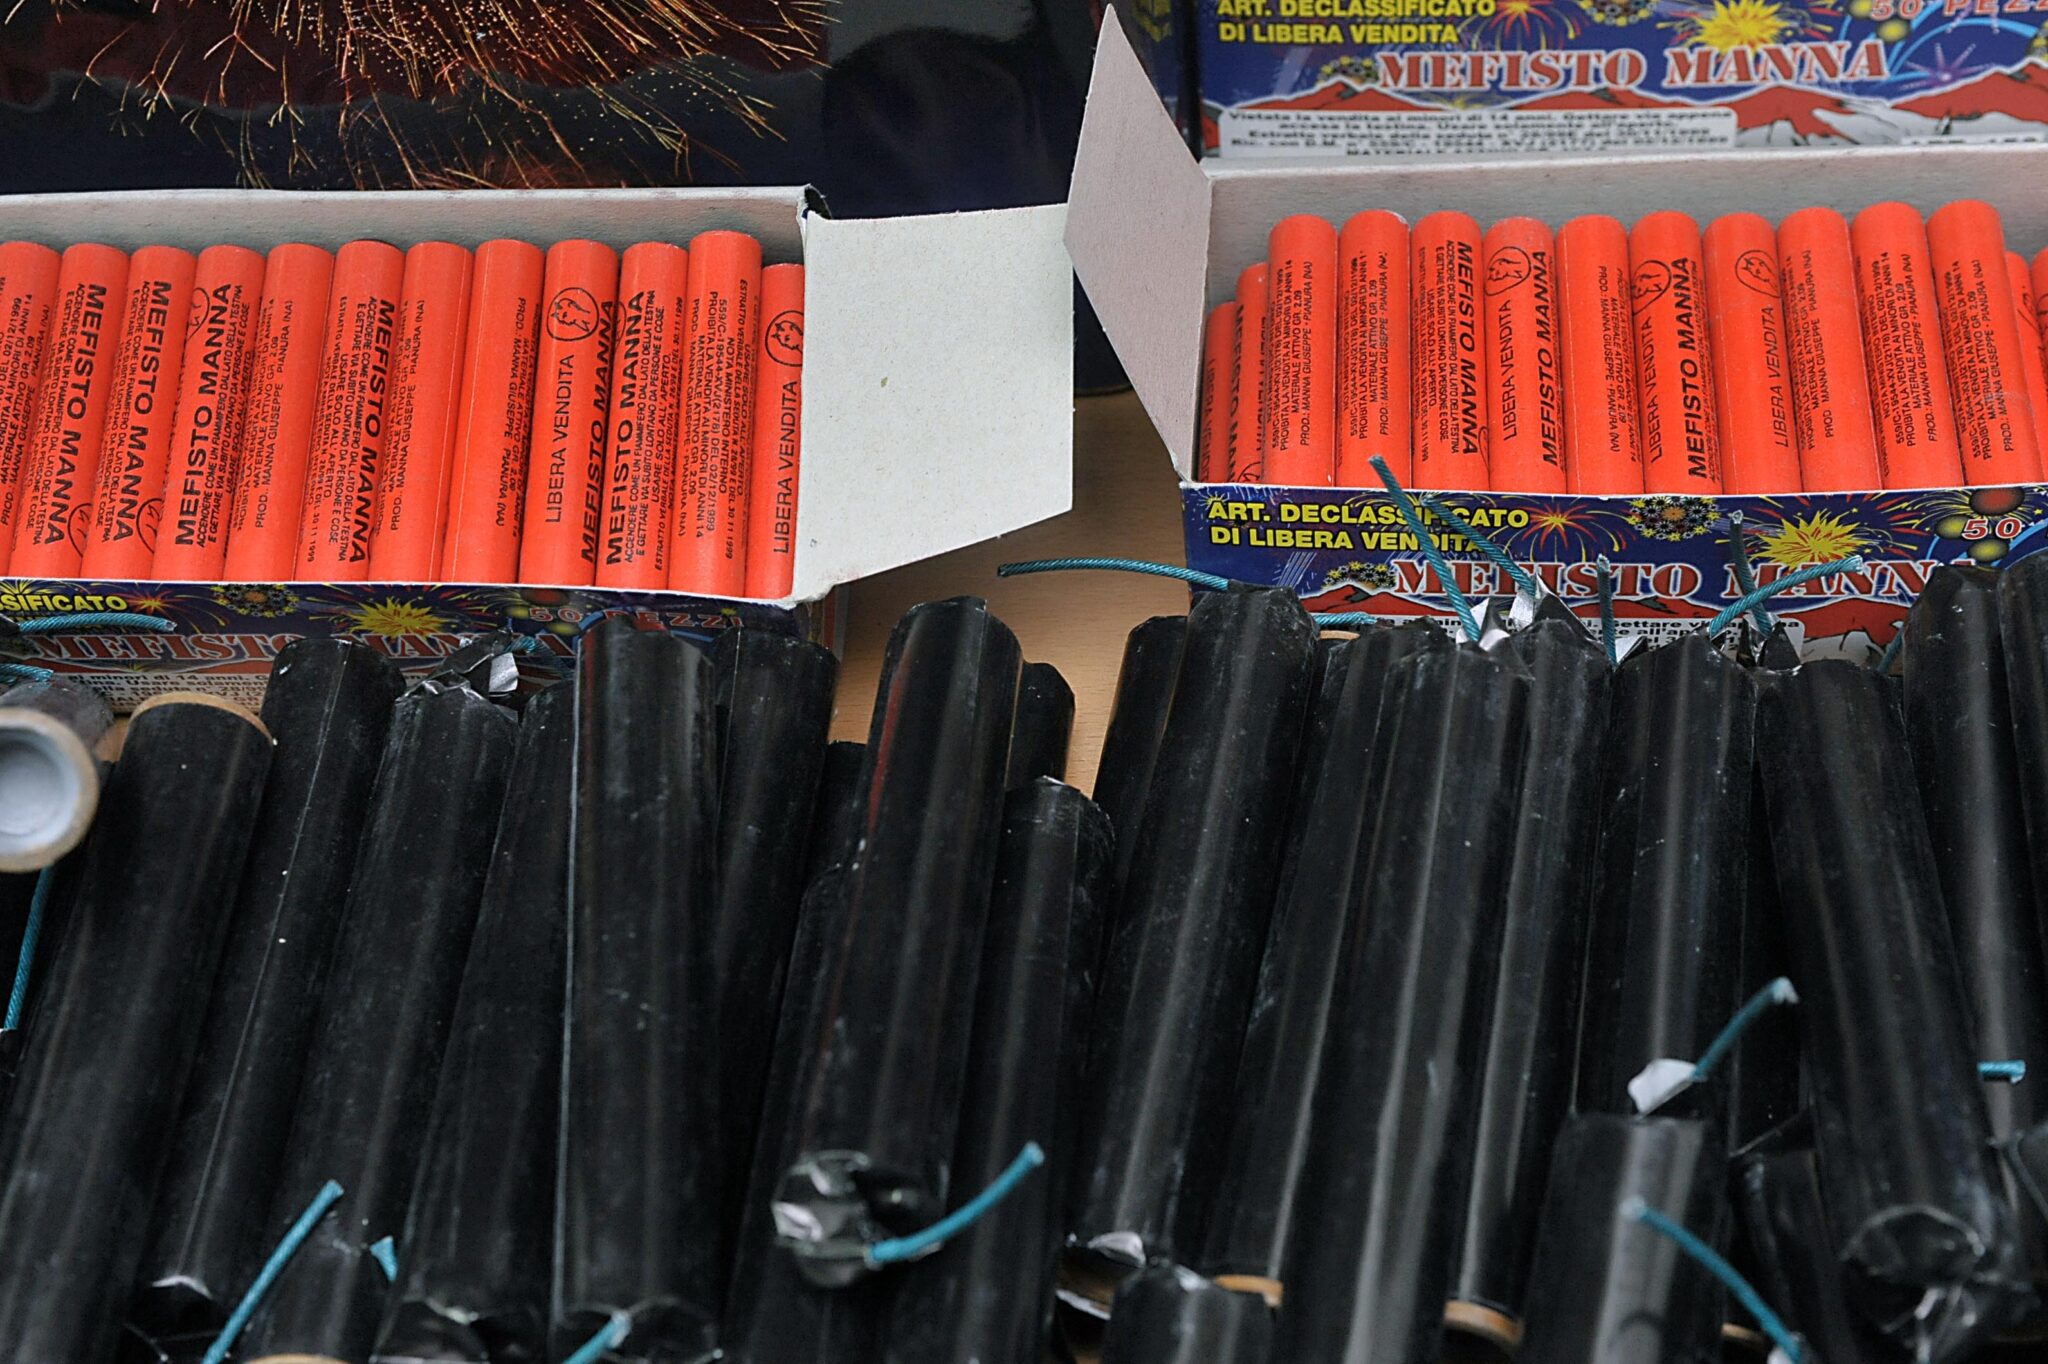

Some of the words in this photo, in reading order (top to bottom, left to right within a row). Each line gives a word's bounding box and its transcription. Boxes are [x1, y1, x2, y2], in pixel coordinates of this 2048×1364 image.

[1217, 0, 1271, 16] ART.
[1280, 0, 1496, 17] DECLASSIFICATO
[1871, 0, 1922, 19] 50
[1220, 24, 1245, 42] DI
[1253, 24, 1344, 43] LIBERA
[1351, 24, 1459, 44] VENDITA
[1377, 50, 1647, 90] MEFISTO
[1664, 39, 1890, 88] MANNA
[1435, 253, 1444, 285] GETTARE
[1446, 240, 1455, 282] ACCENDERE
[1901, 253, 1912, 272] (NA)
[1302, 281, 1312, 320] PIANURA
[1426, 289, 1434, 318] USARE
[1436, 287, 1444, 297] VIA
[1446, 284, 1455, 304] COME
[1447, 306, 1455, 316] UN
[1457, 241, 1475, 352] MEFISTO
[1532, 250, 1550, 342] MANNA
[1670, 257, 1695, 351] MANNA
[1904, 274, 1919, 315] PIANURA
[352, 309, 365, 351] GETTARE
[362, 296, 377, 350] ACCENDERE
[705, 290, 718, 345] PROIBITA
[1436, 299, 1445, 325] SUBITO
[1600, 298, 1610, 332] MANNA
[65, 283, 106, 421] MEFISTO
[132, 280, 172, 415] MEFISTO
[619, 289, 644, 408] MANNA
[1292, 327, 1301, 359] ATTIVO
[1301, 328, 1311, 373] GIUSEPPE
[1426, 321, 1434, 346] SOLO
[1437, 327, 1445, 362] LONTANO
[1498, 299, 1513, 374] VENDITA
[1760, 305, 1781, 379] VENDITA
[1900, 320, 1913, 353] ATTIVO
[1911, 322, 1926, 368] GIUSEPPE
[336, 353, 348, 391] USARE
[349, 352, 359, 368] VIA
[359, 352, 370, 379] COME
[363, 298, 396, 438] MEFISTO
[693, 334, 706, 399] MATERIALE
[704, 347, 714, 362] LA
[1437, 363, 1446, 373] DA
[1448, 362, 1457, 375] DAL
[1602, 333, 1614, 381] GIUSEPPE
[1638, 316, 1658, 395] VENDITA
[345, 368, 357, 402] SUBITO
[357, 381, 367, 394] UN
[552, 353, 575, 442] VENDITA
[701, 363, 713, 416] VENDITA
[1291, 361, 1300, 413] MATERIALE
[1300, 376, 1310, 410] MANNA
[1438, 375, 1446, 409] PERSONE
[1448, 378, 1457, 396] LATO
[1905, 357, 1920, 408] MATERIALE
[1918, 370, 1932, 406] MANNA
[174, 404, 213, 547] MEFISTO
[197, 280, 232, 396] MANNA
[332, 394, 342, 423] SOLO
[340, 403, 353, 448] LONTANO
[690, 402, 701, 445] ATTIVO
[700, 418, 710, 428] AI
[777, 379, 797, 470] VENDITA
[1449, 398, 1458, 421] DELLA
[1460, 358, 1477, 454] MANNA
[1501, 375, 1517, 440] LIBERA
[1537, 348, 1557, 466] MEFISTO
[1606, 388, 1617, 430] PIANURA
[1679, 358, 1706, 479] MEFISTO
[1769, 385, 1788, 448] LIBERA
[580, 419, 604, 563] MEFISTO
[592, 298, 613, 411] MANNA
[1449, 423, 1458, 453] TESTINA
[1609, 432, 1619, 452] (NA)
[1645, 395, 1663, 463] LIBERA
[338, 448, 347, 462] DA
[348, 451, 358, 468] DAL
[698, 429, 709, 474] MINORI
[709, 436, 719, 462] DEL
[44, 429, 82, 547] MANNA
[112, 424, 149, 543] MANNA
[332, 463, 346, 507] PERSONE
[345, 469, 356, 492] LATO
[545, 446, 566, 523] LIBERA
[606, 418, 633, 566] MEFISTO
[697, 475, 706, 488] DI
[705, 463, 718, 531] 02/12/1999
[342, 495, 353, 523] DELLA
[348, 446, 378, 564] MANNA
[695, 490, 706, 522] ANNI
[773, 476, 792, 553] LIBERA
[1208, 502, 1271, 522] ART.
[337, 524, 350, 561] TESTINA
[694, 525, 703, 538] 14
[1211, 526, 1240, 545] DI
[1250, 528, 1353, 550] LIBERA
[1962, 518, 2022, 540] 50
[529, 607, 583, 623] 50
